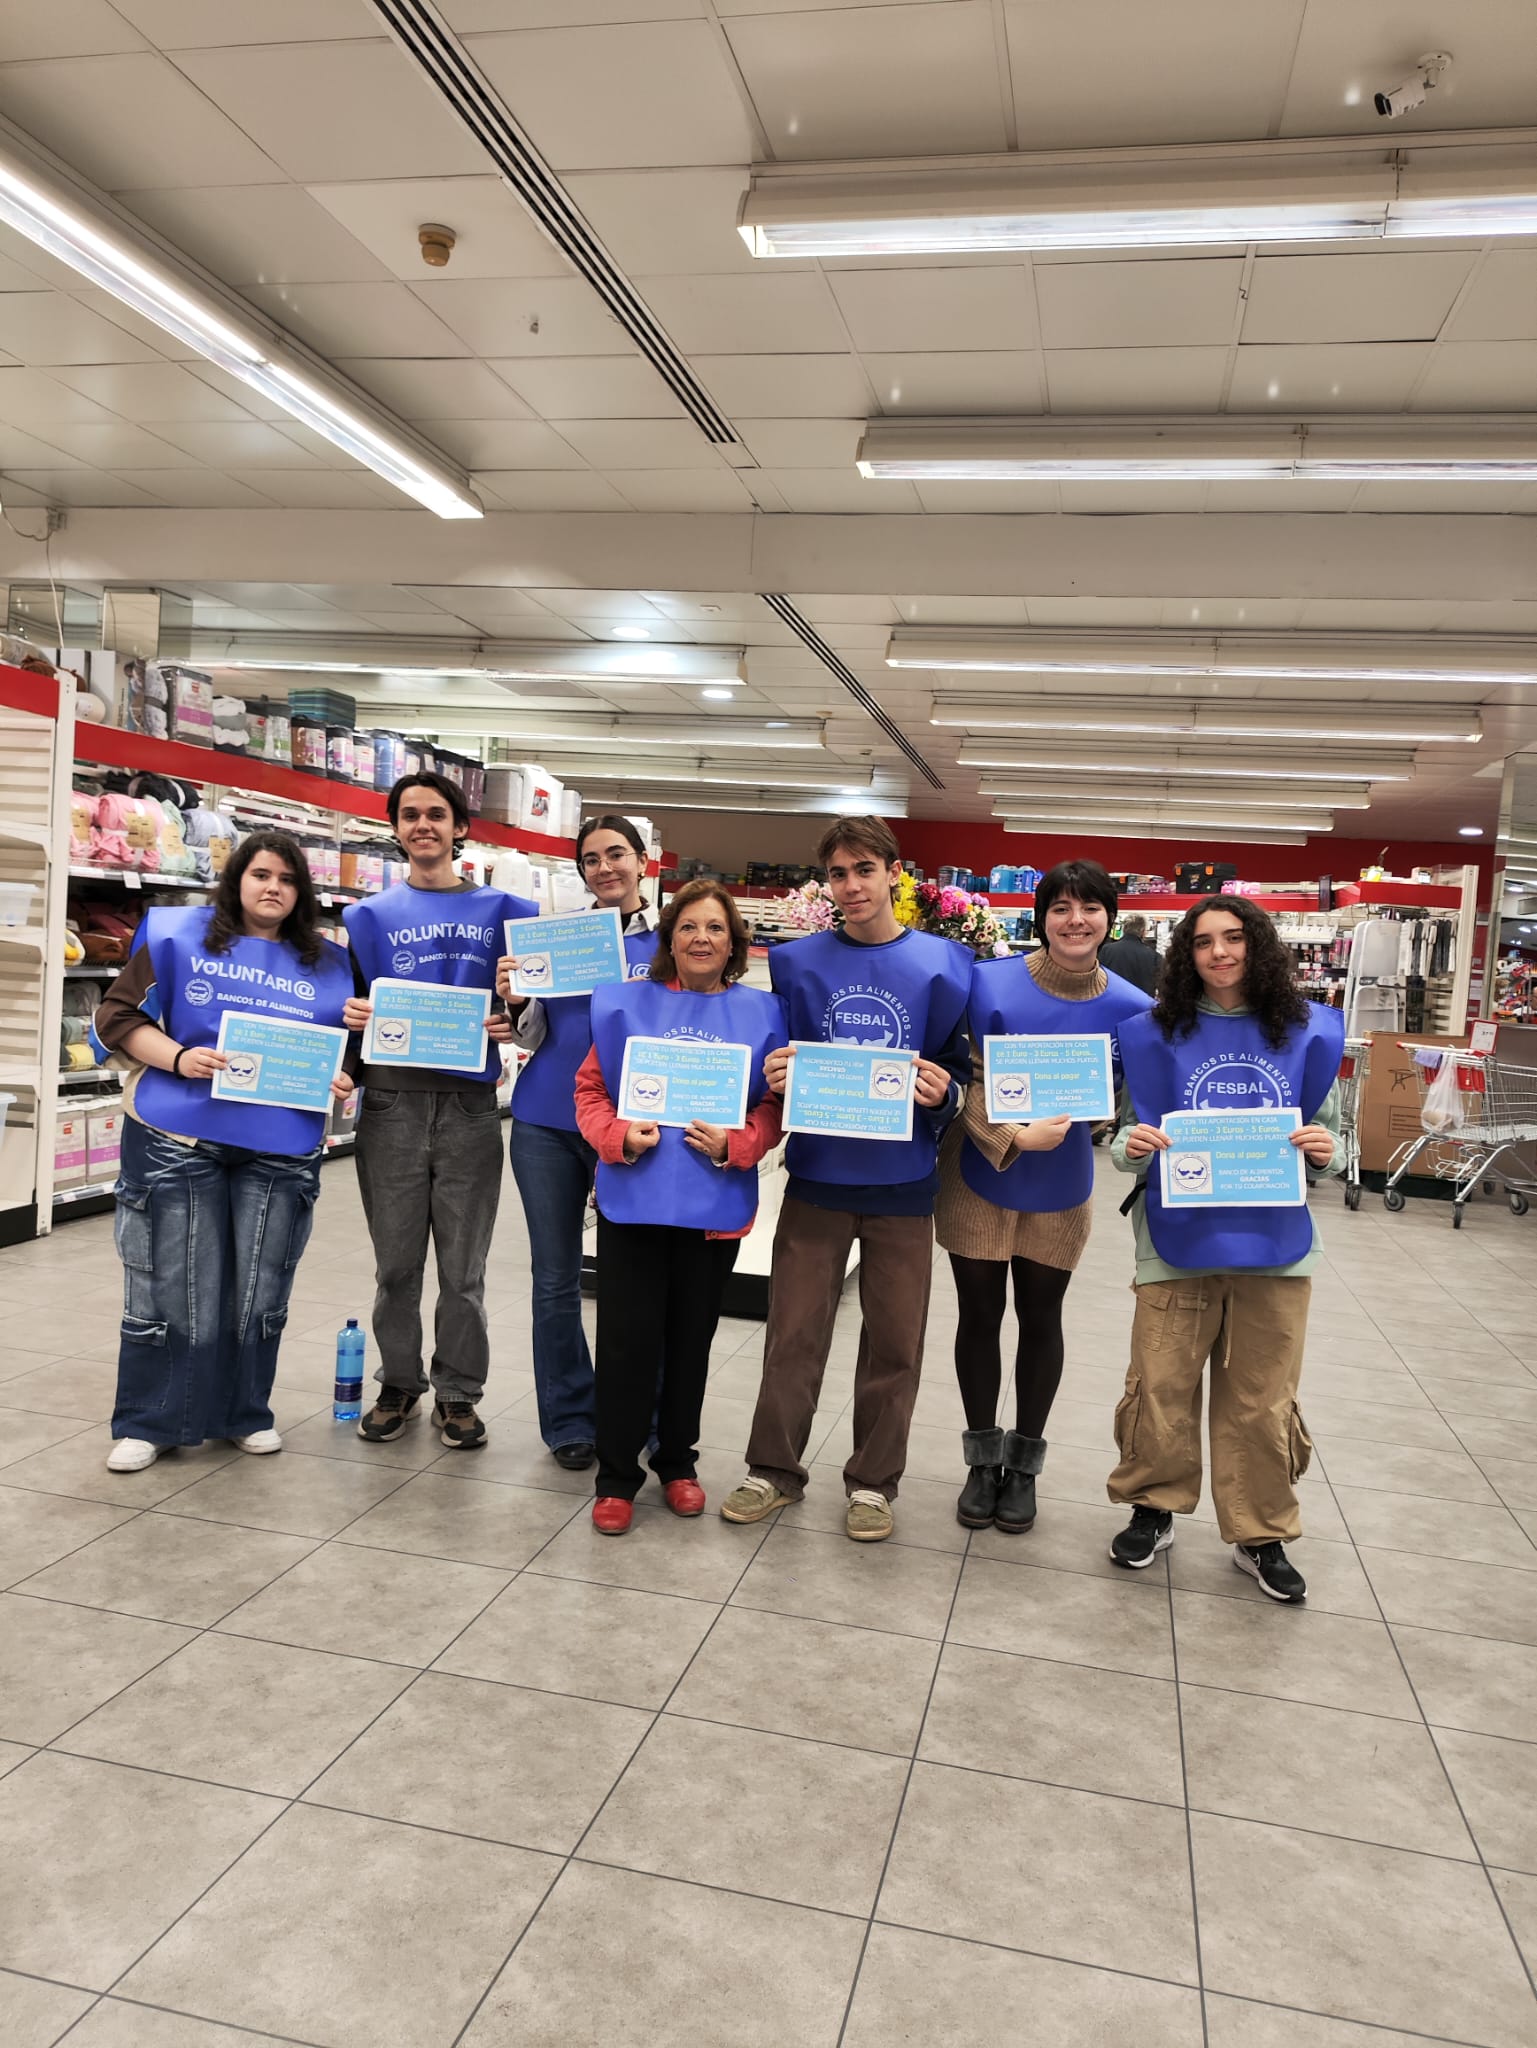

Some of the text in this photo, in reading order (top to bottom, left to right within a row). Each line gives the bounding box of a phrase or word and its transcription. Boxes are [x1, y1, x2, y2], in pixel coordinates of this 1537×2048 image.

[387, 922, 495, 948] VOLUNTARI@
[419, 953, 447, 964] BANCOS
[190, 956, 316, 1001] VOLUNTARI@
[217, 992, 254, 1006] BANCOS
[256, 999, 267, 1008] DE
[269, 1001, 314, 1019] ALIMENTOS
[821, 984, 911, 1030] BANCOS DE ALIMENTOS
[835, 1012, 890, 1026] FESBAL
[680, 1026, 694, 1034] DE
[1184, 1053, 1292, 1097] BANCOS DE ALIMENTOS
[1207, 1081, 1269, 1094] FESBAL
[1191, 1126, 1208, 1134] Euro
[1222, 1125, 1243, 1133] Euros
